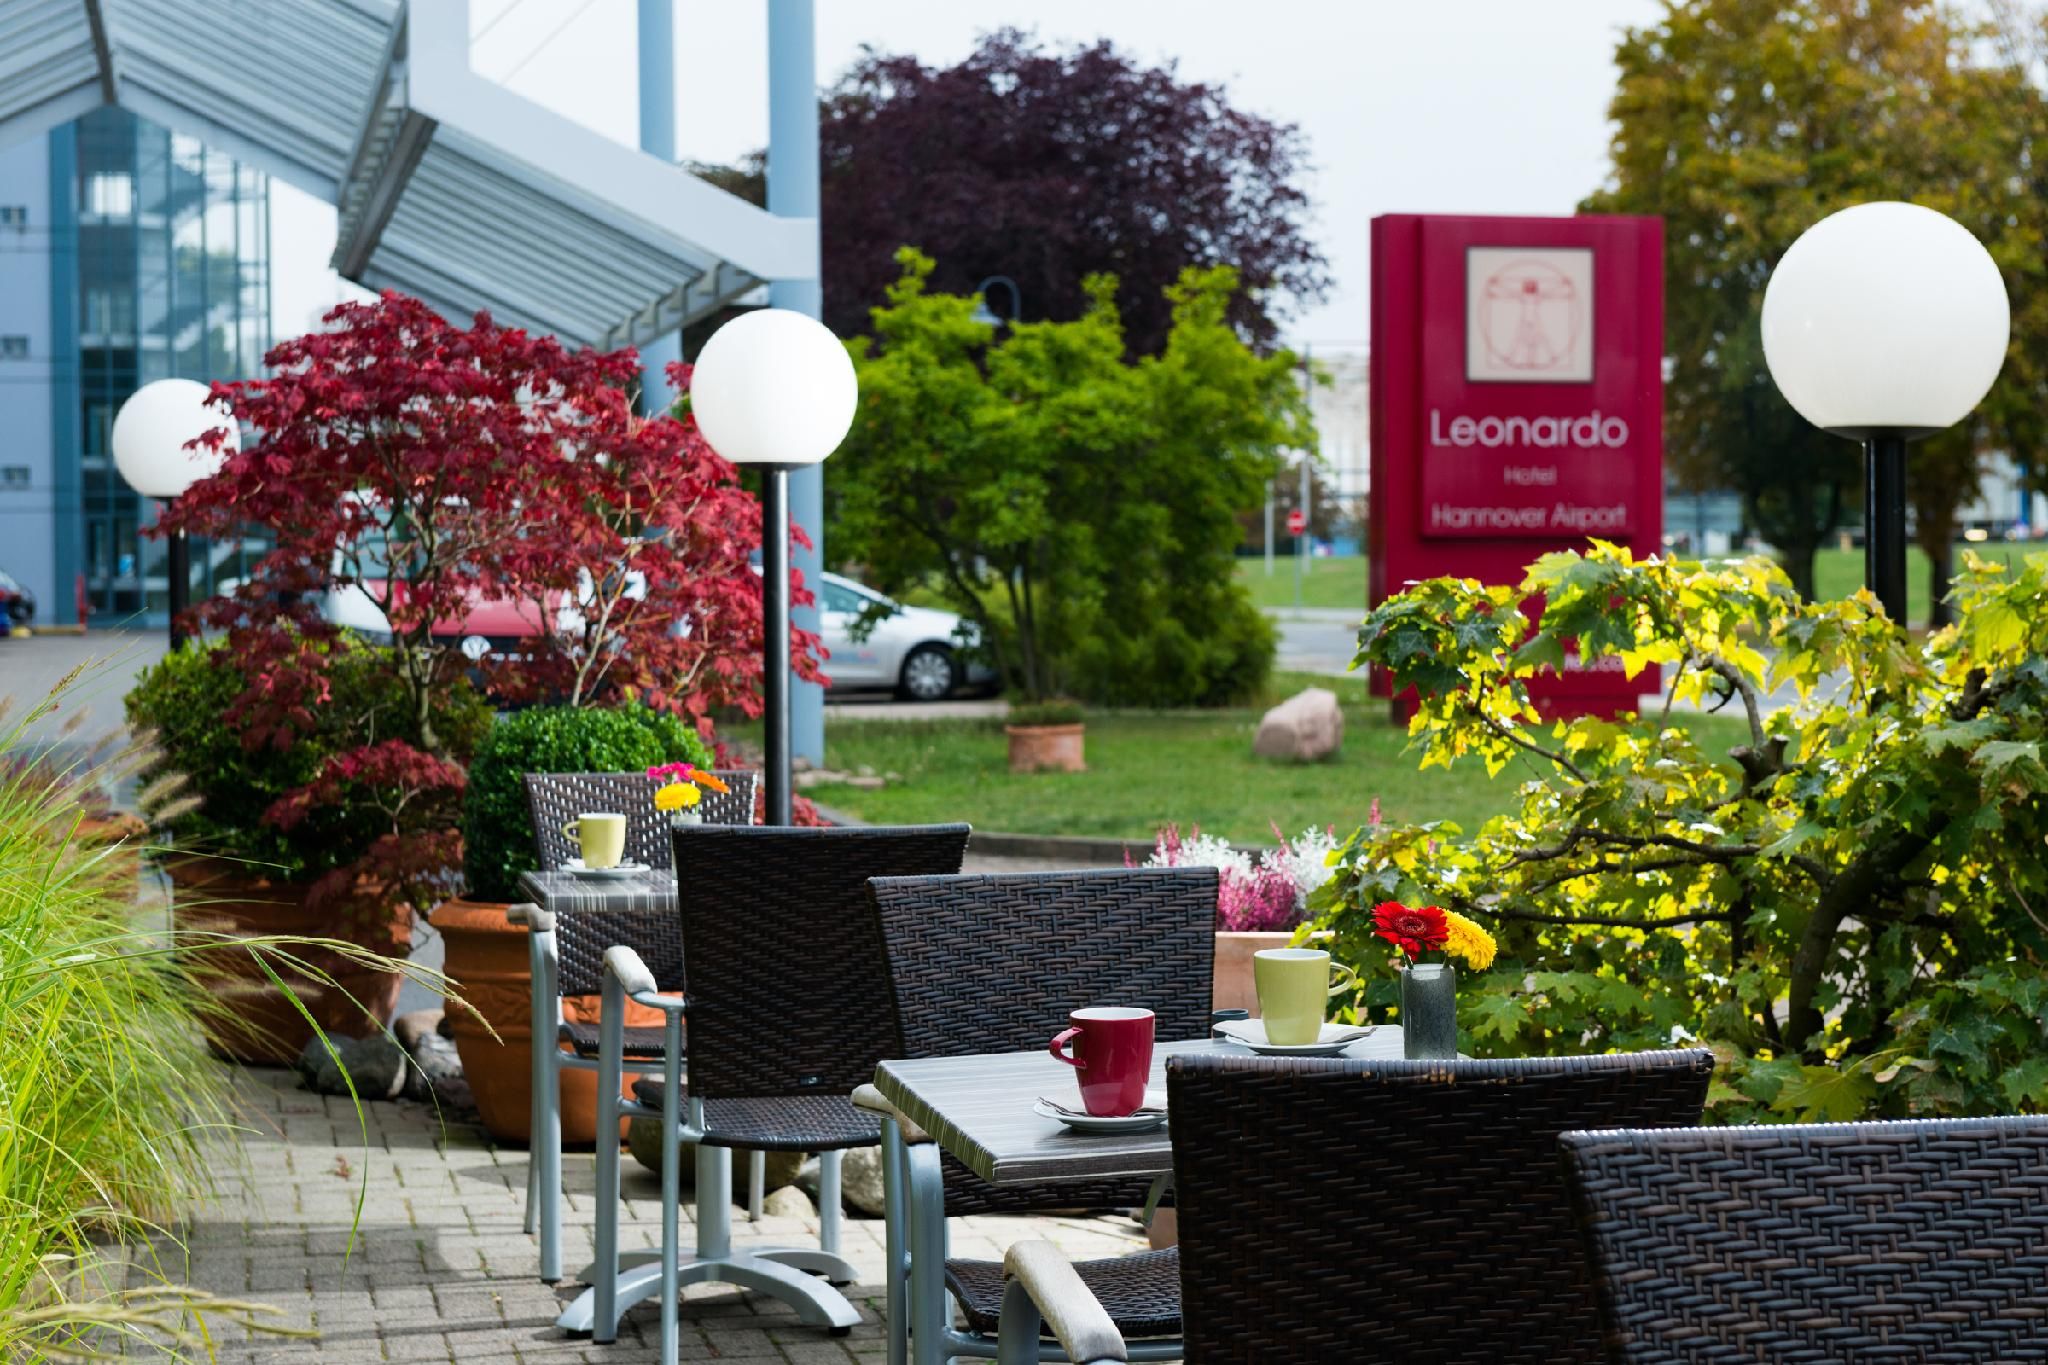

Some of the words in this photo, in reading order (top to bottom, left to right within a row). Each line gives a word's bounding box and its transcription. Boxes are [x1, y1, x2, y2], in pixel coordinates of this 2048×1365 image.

[1430, 409, 1629, 447] Leonardo
[1503, 465, 1557, 485] Hotel
[1431, 503, 1545, 528] Hannover
[1551, 502, 1627, 530] Airport
